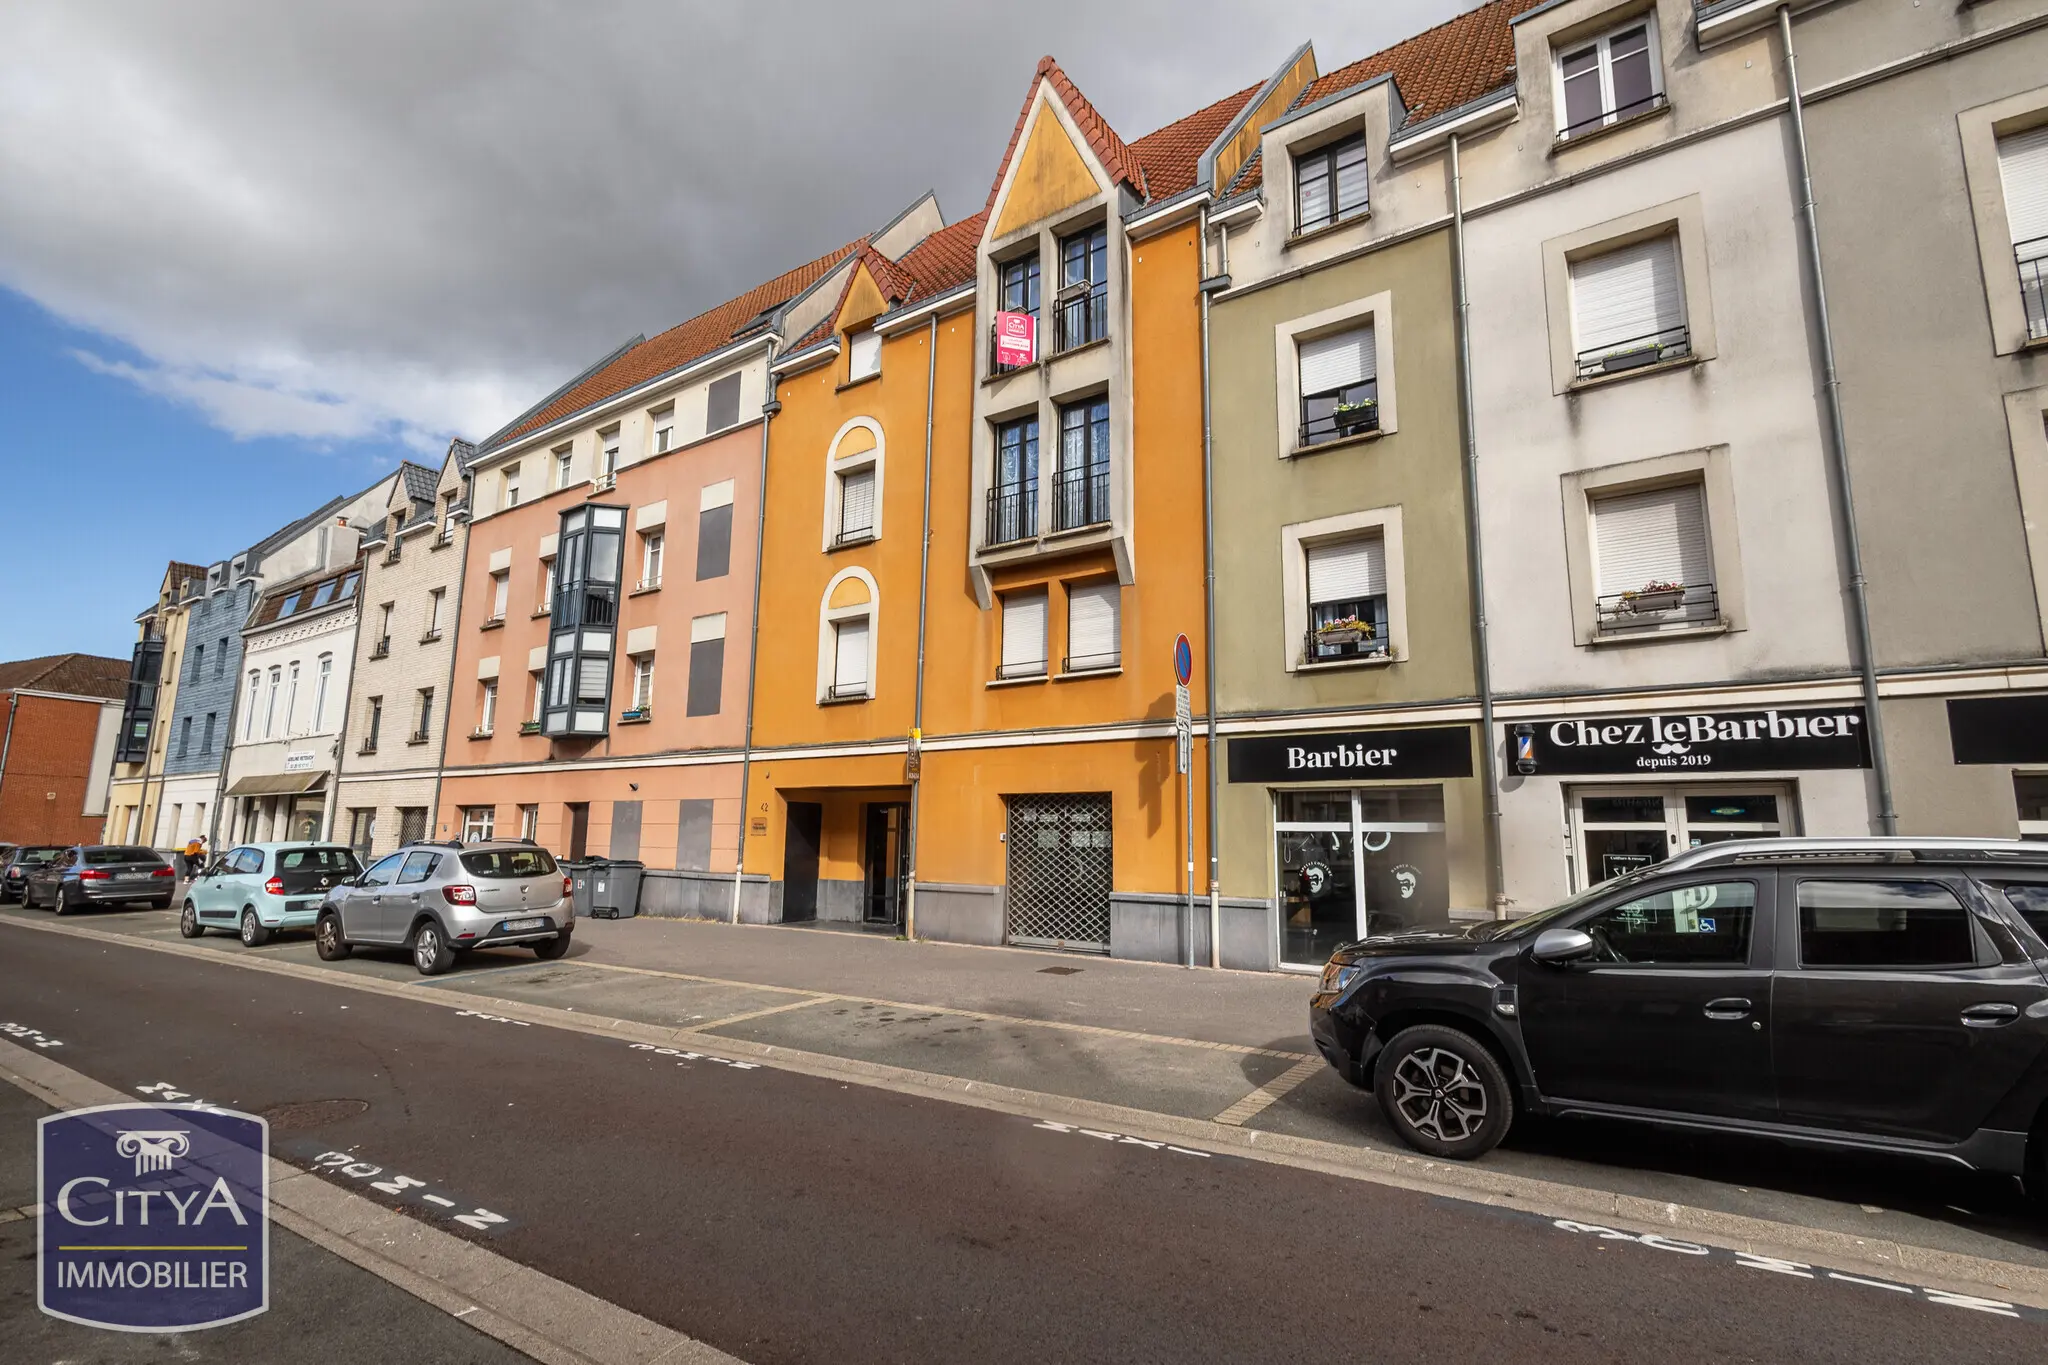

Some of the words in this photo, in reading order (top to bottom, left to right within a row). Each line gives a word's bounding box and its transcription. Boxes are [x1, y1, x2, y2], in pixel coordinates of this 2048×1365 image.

[1550, 721, 1646, 747] Chez
[1287, 743, 1398, 769] Barbier
[1636, 756, 1677, 770] depuis
[1680, 754, 1712, 767] 2019
[760, 802, 769, 812] 42
[1032, 1119, 1212, 1158] MAXI
